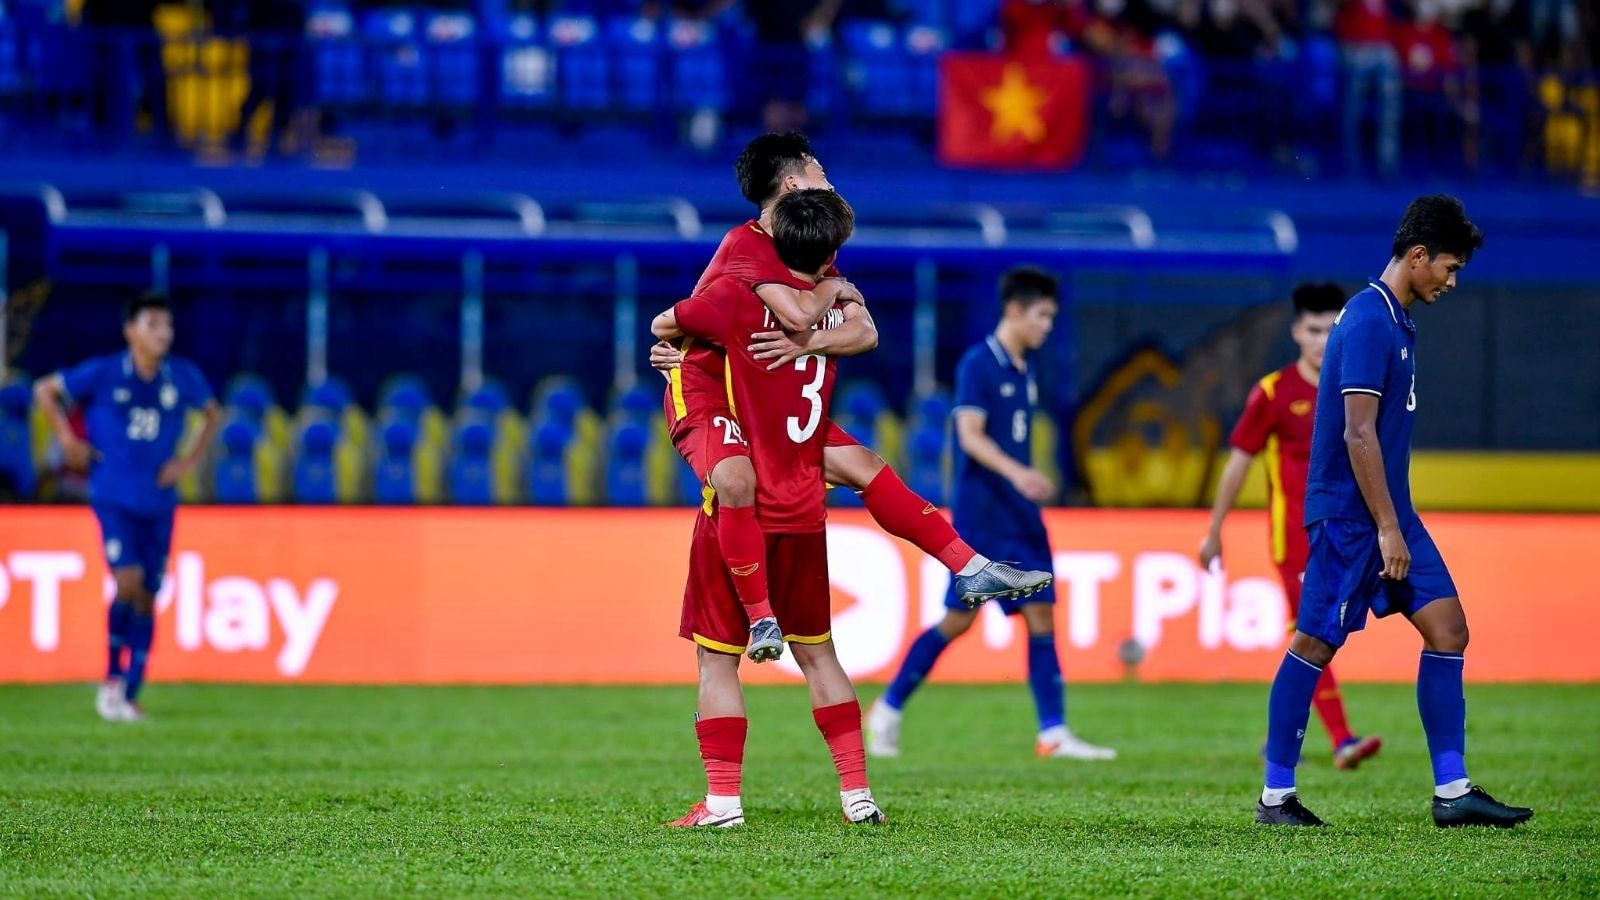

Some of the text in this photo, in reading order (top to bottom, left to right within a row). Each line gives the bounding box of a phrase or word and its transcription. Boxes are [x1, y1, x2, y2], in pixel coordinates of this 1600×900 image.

[786, 354, 827, 444] 3
[0, 550, 339, 676] T lay
[1133, 551, 1289, 652] Pla
